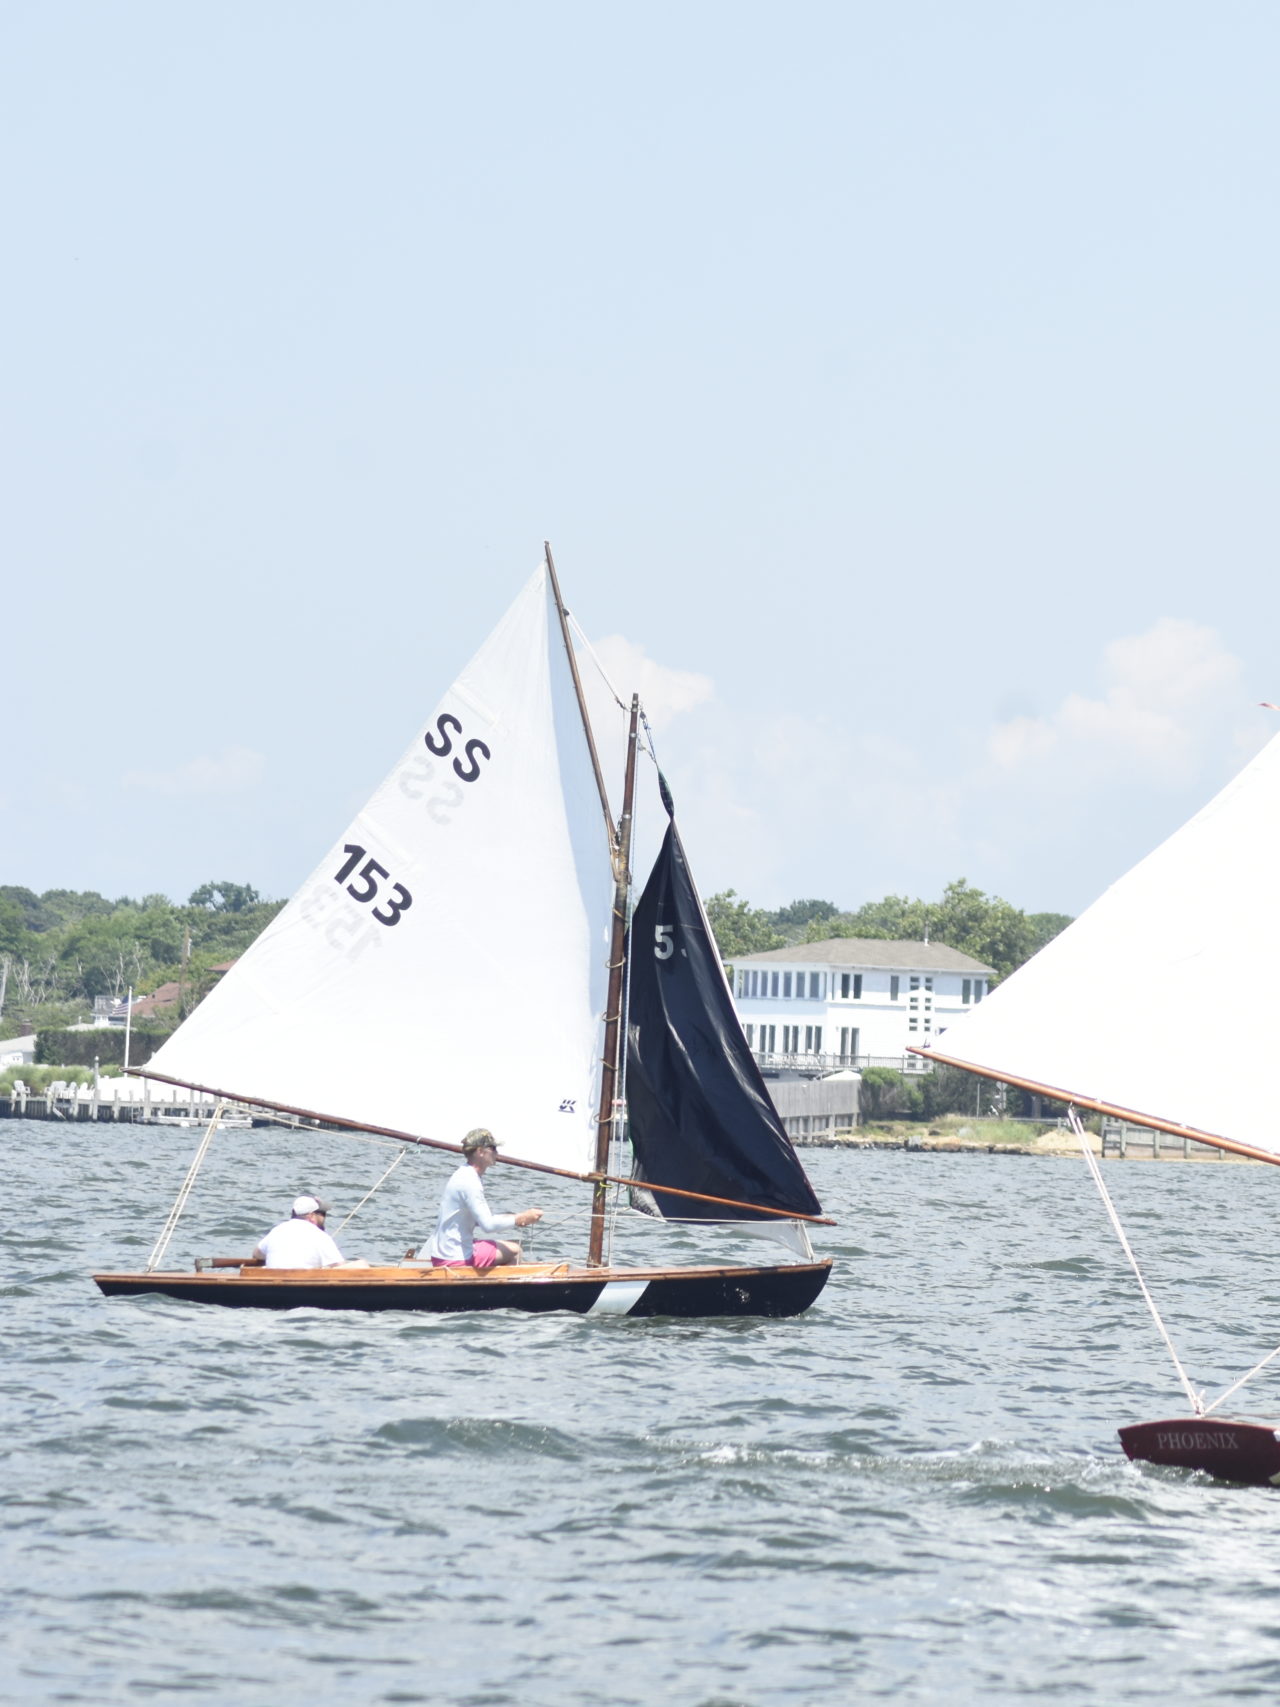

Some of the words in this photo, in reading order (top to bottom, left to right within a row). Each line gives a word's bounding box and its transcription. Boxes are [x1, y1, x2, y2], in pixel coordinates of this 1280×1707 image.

[424, 713, 491, 783] SS
[334, 843, 413, 927] 153
[1156, 1432, 1239, 1450] PHOENIX
